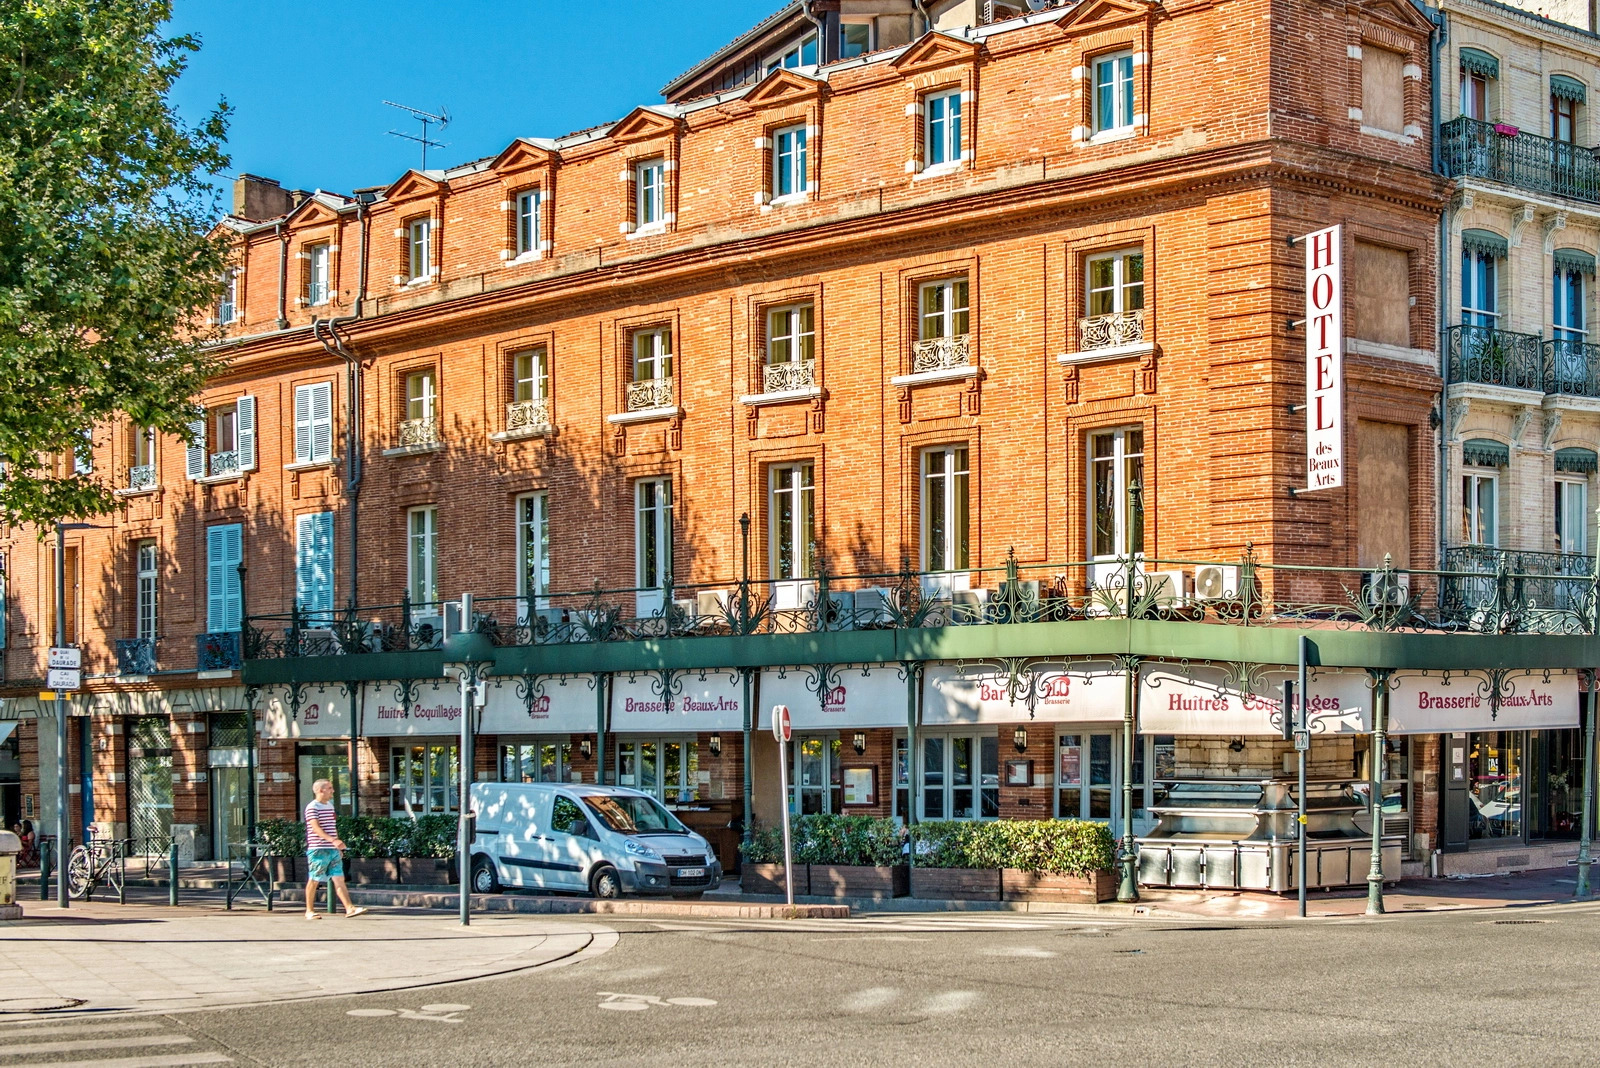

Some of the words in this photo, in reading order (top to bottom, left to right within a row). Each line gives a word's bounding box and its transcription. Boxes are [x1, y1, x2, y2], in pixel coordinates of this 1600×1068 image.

[1311, 230, 1334, 432] HOTEL
[1315, 441, 1333, 456] des
[1309, 457, 1340, 472] Beaux
[1314, 472, 1336, 487] Arts
[980, 684, 1005, 701] Bar
[1419, 691, 1480, 709] Brasserie
[1490, 689, 1552, 708] eaux-Arts
[625, 697, 675, 713] Brassere
[682, 696, 738, 712] Beaux-Arts
[1168, 693, 1229, 711] Huîtres
[378, 706, 409, 719] Huître
